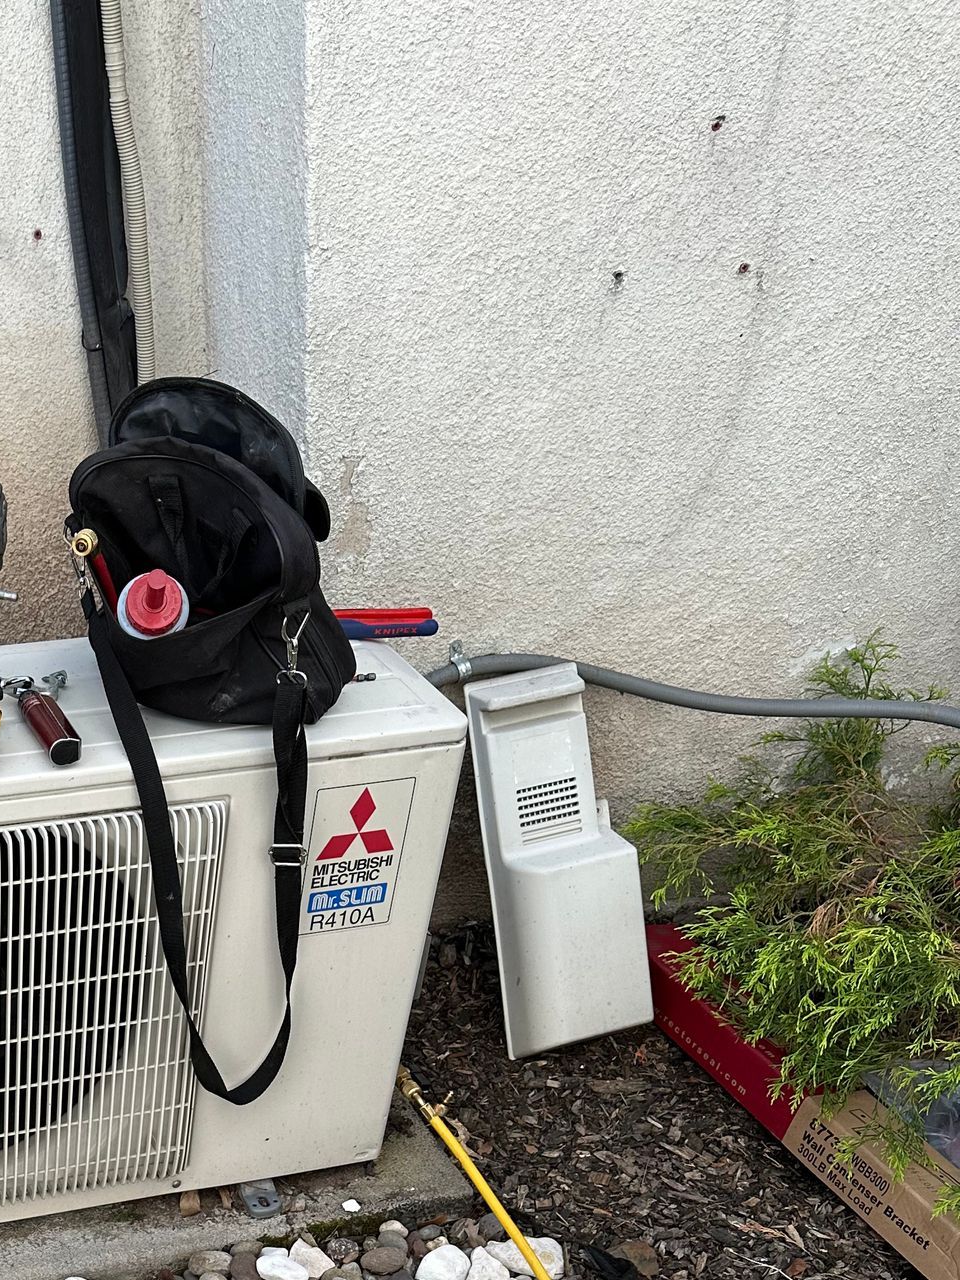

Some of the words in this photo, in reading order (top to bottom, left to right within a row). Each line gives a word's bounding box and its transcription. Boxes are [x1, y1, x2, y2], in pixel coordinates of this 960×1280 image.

[374, 627, 417, 635] KNIPEX
[312, 855, 393, 876] MITSUBISHI
[310, 869, 380, 889] ELECTRIC
[309, 906, 375, 931] R410A
[797, 1143, 827, 1175] 300LB
[826, 1170, 847, 1194] Max
[847, 1187, 874, 1216] Load
[850, 1152, 891, 1197] WBB300)
[802, 1130, 826, 1156] Wall
[883, 1204, 931, 1251] Bracket
